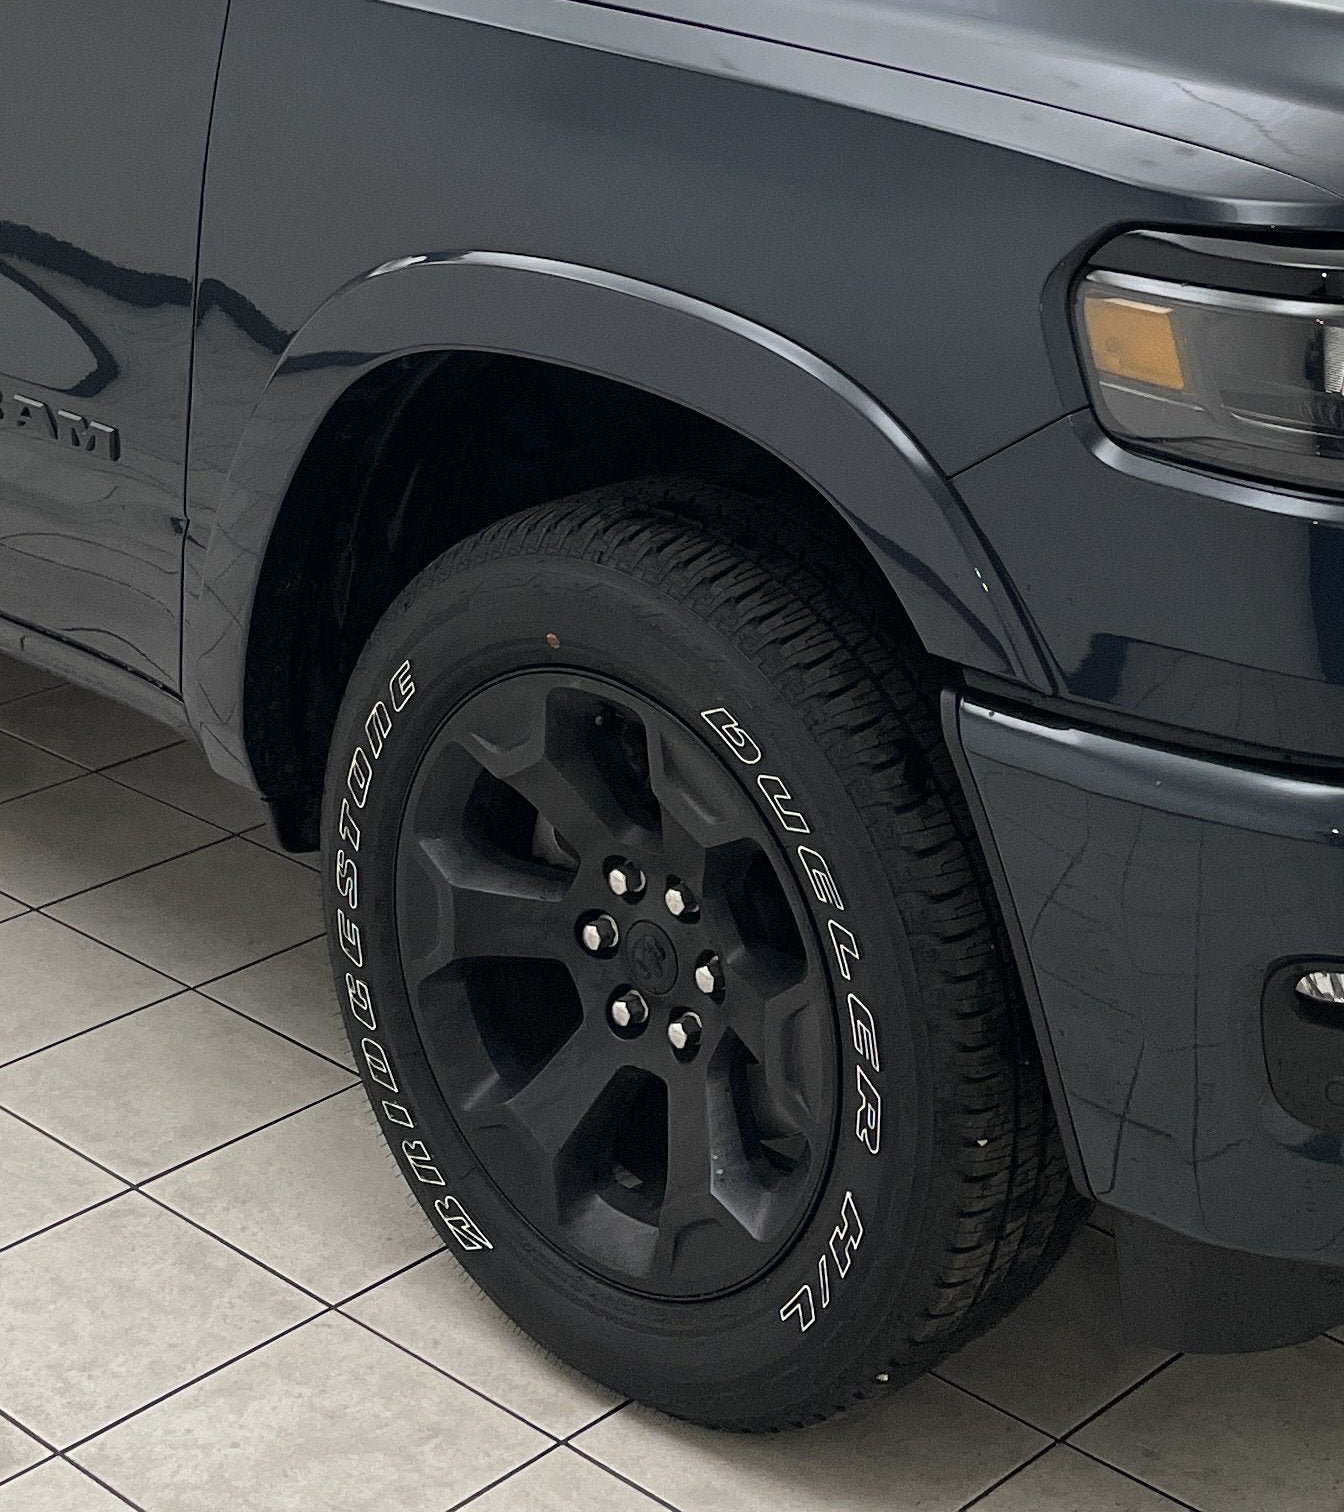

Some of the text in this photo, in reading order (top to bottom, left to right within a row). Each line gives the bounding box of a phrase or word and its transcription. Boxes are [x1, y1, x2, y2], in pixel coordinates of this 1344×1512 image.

[337, 660, 494, 1250] BRIDGESTONE
[700, 707, 882, 1333] DUELER H/L
